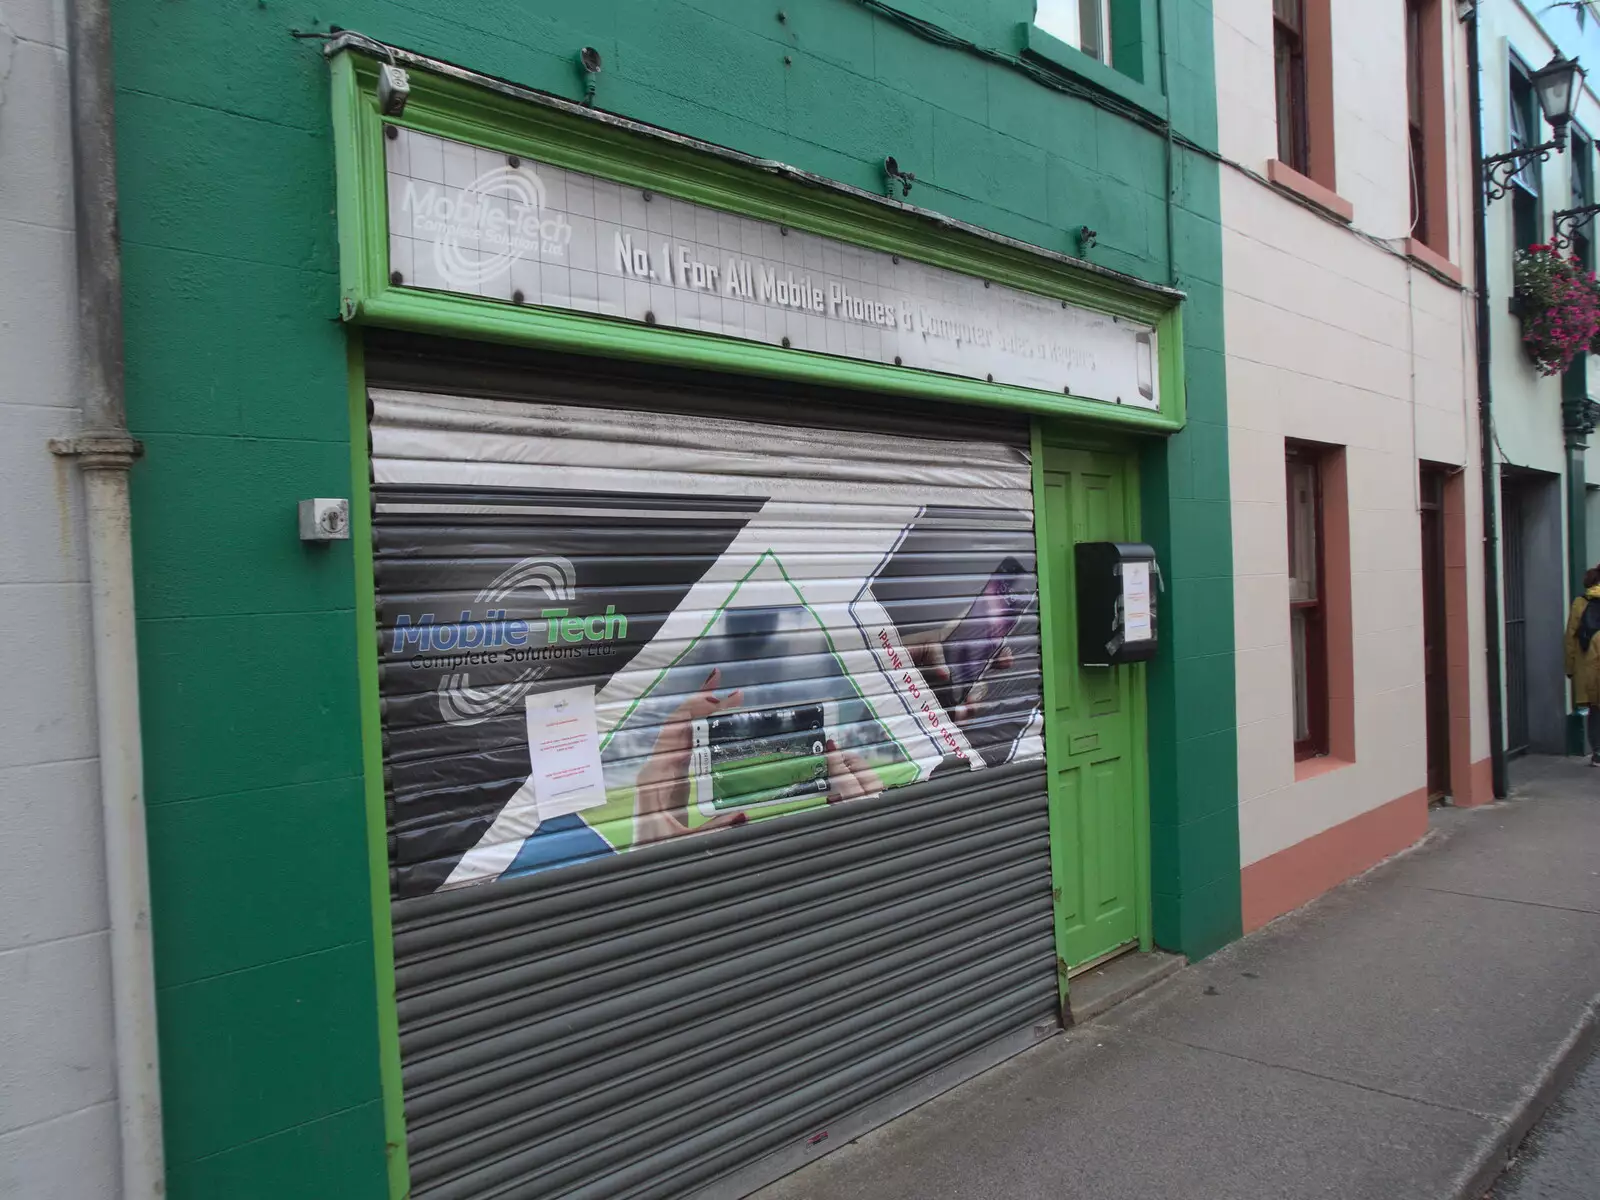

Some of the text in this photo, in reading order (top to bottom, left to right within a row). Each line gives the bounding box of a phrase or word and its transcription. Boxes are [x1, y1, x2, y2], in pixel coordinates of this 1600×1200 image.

[402, 181, 572, 244] Mobile-Tech
[413, 214, 481, 239] Complete
[541, 241, 564, 256] Ltd.
[614, 231, 655, 279] No.
[662, 242, 672, 284] 1
[678, 245, 718, 289] For
[726, 257, 756, 297] All
[760, 264, 824, 312] Mobile
[828, 280, 897, 327] Phones
[392, 605, 628, 653] Mobile-Tech
[410, 640, 616, 670] Complete Solutions Ltd.
[878, 628, 903, 671] iPHONE
[920, 700, 940, 728] iPOD
